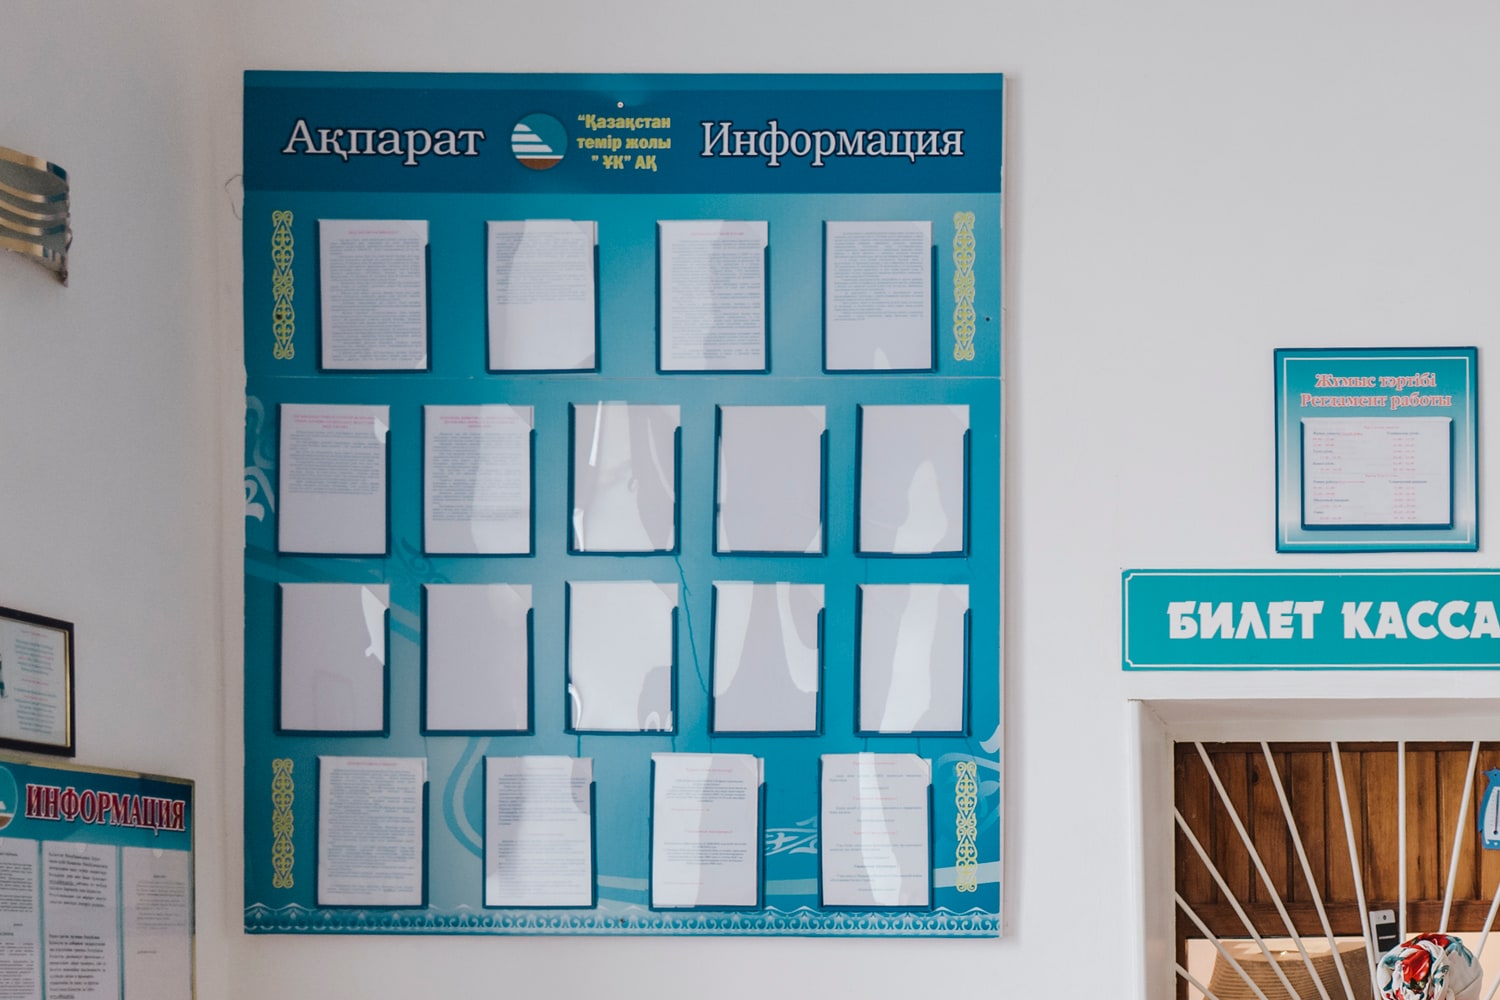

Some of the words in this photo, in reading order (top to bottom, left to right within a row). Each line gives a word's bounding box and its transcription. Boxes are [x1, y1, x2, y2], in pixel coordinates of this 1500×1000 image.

[281, 118, 486, 166] Ақпарат
[576, 134, 622, 152] темір
[625, 137, 672, 149] жолы
[700, 119, 965, 168] Информация
[634, 154, 658, 172] АҚ
[1300, 393, 1388, 408] Регламент
[1390, 392, 1453, 410] работы
[1166, 600, 1324, 640] БИЛЕТ
[25, 783, 186, 837] ИНФОРМАЦИЯ
